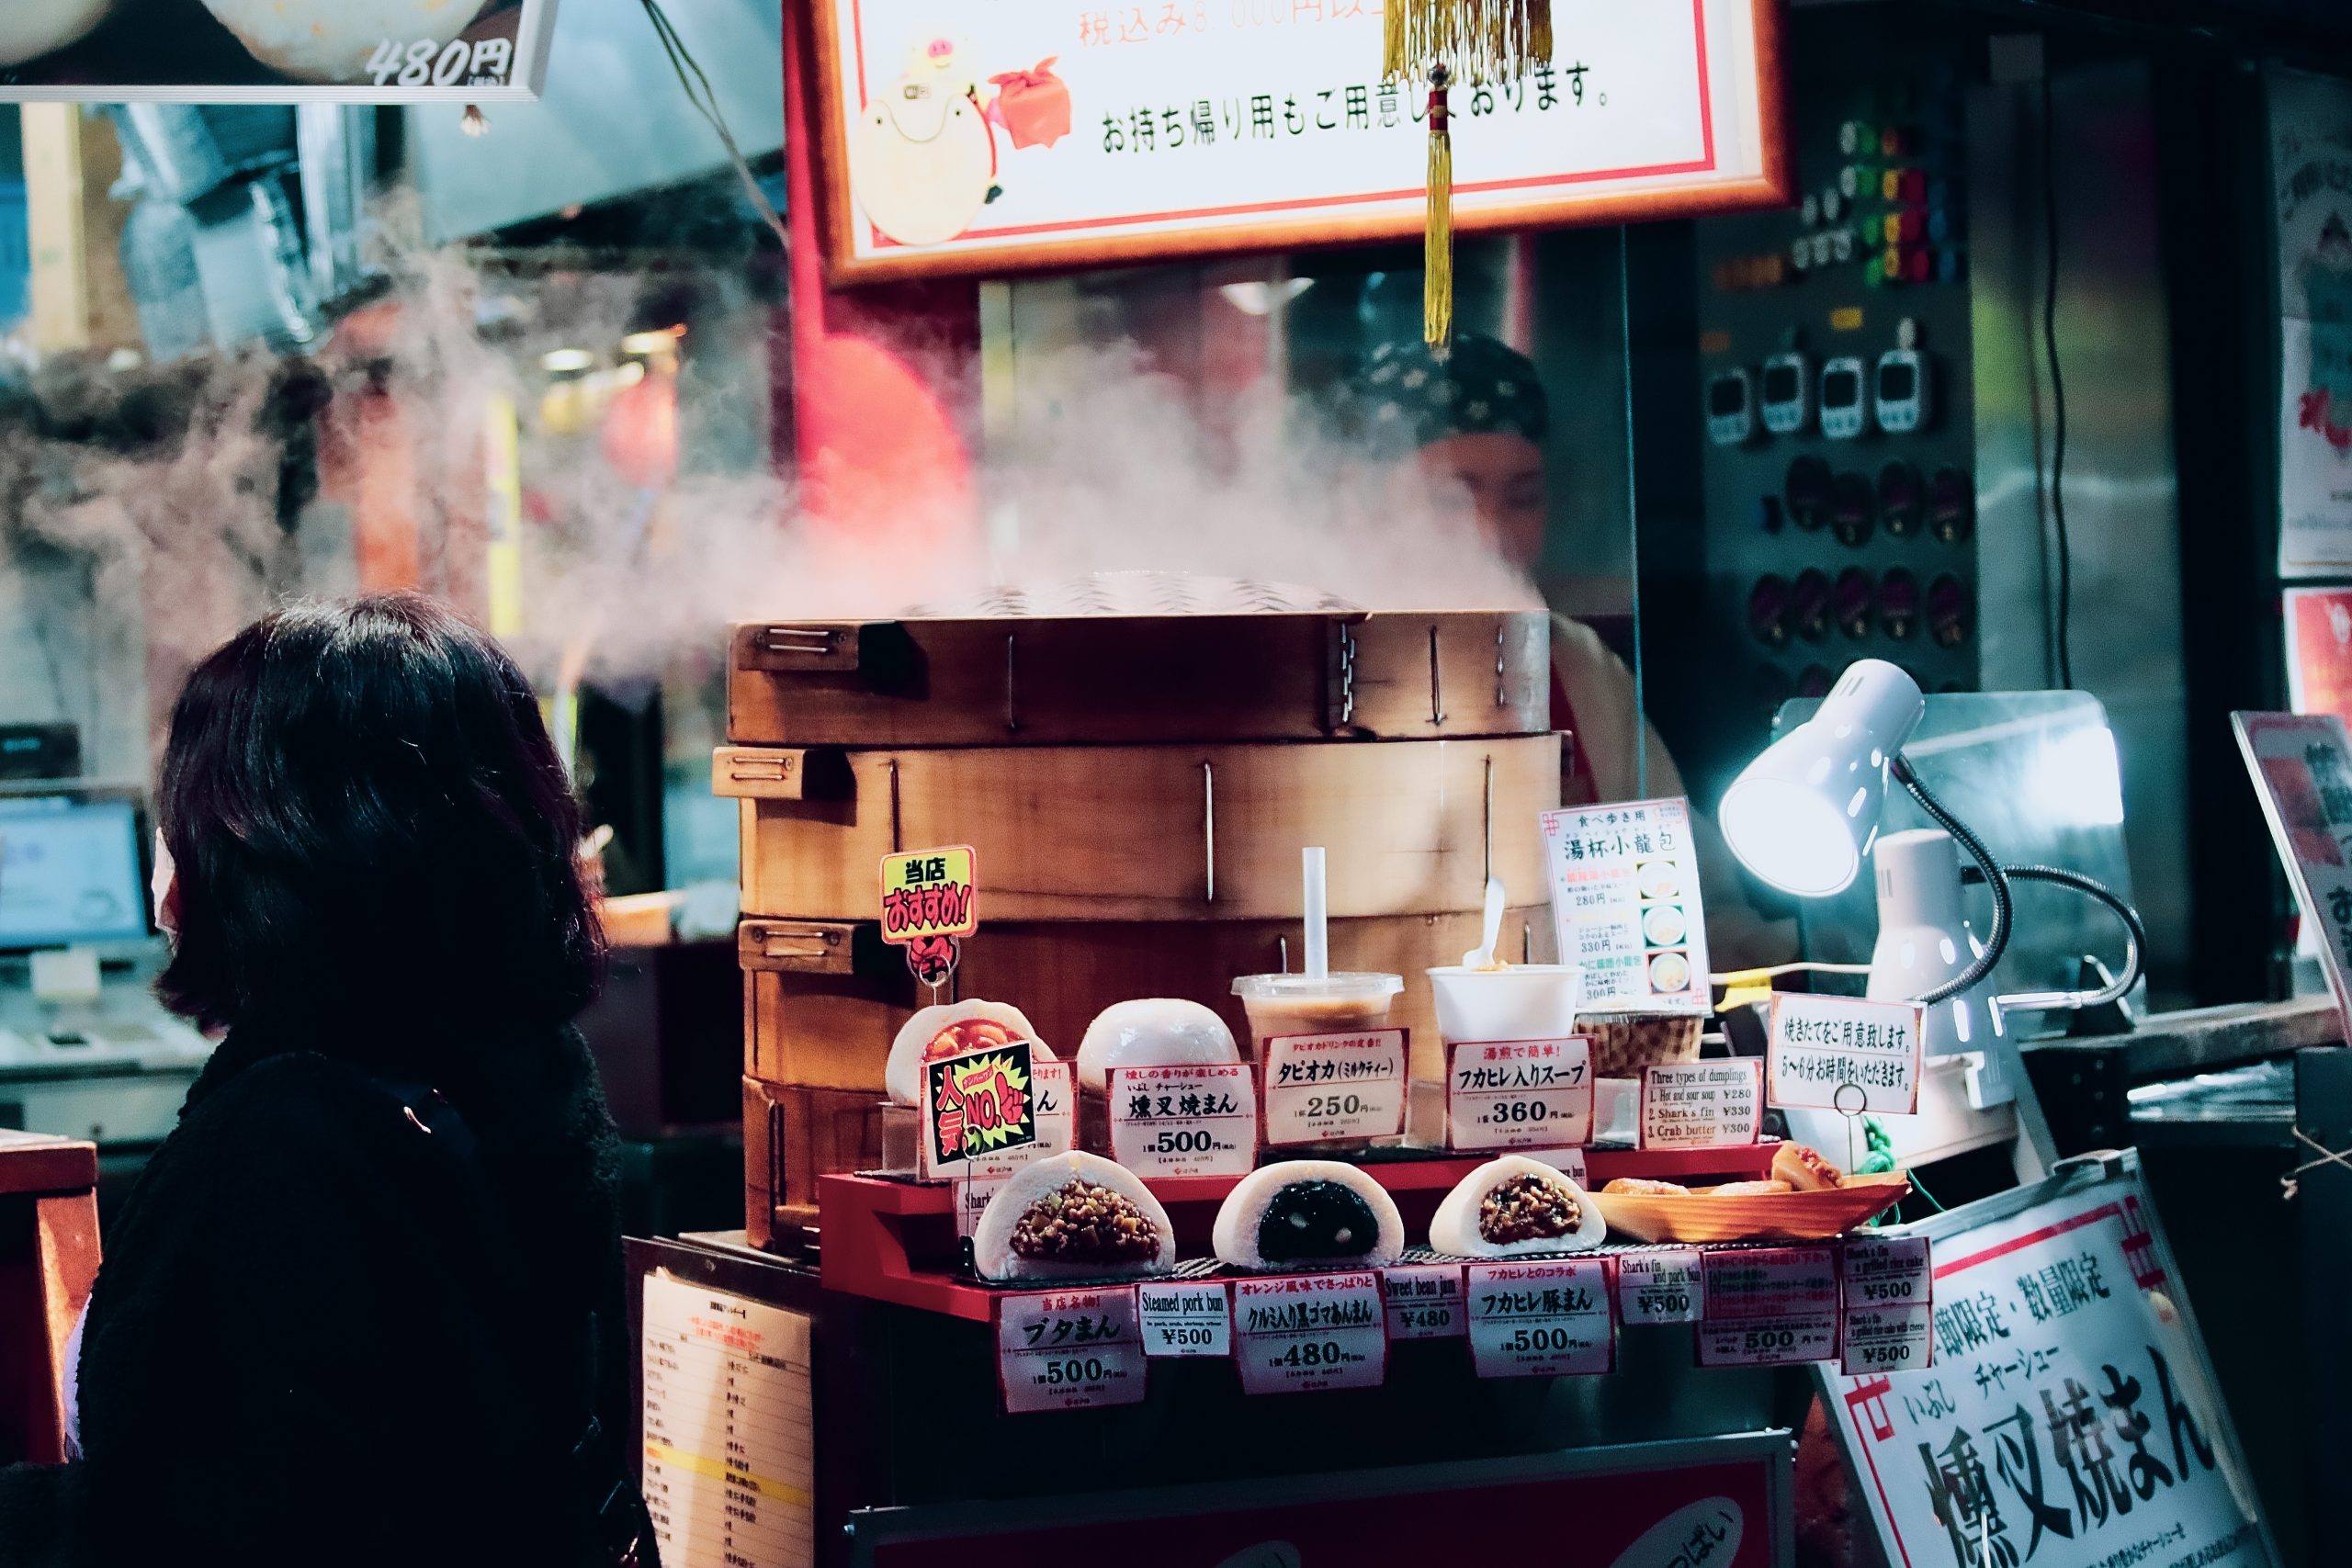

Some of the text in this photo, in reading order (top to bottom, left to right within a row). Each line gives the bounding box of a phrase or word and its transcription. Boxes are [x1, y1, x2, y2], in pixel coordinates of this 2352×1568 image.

[366, 38, 513, 86] 480円
[1102, 61, 1609, 154] お持ち帰り用もご用意しおります。
[1578, 809, 1646, 829] 食べ歩き用
[905, 857, 946, 885] 当店
[884, 881, 971, 933] おすすめ!
[1576, 894, 1606, 906] 280円
[1784, 1015, 1911, 1054] 焼きたてをご用意致します。
[1458, 1060, 1587, 1089] フカヒレ入りスープ
[1651, 1067, 1747, 1085] Three types of dumplings
[1673, 1088, 1685, 1102] and
[1686, 1089, 1700, 1101] sour
[1702, 1089, 1716, 1101] soup
[1723, 1089, 1752, 1100] ¥280
[935, 1065, 965, 1156] 人気
[1657, 1109, 1697, 1119] Sharks
[1700, 1107, 1714, 1117] fin
[1723, 1106, 1751, 1117] ¥330
[1657, 1124, 1682, 1137] Crab
[1686, 1123, 1716, 1134] butter
[1722, 1123, 1750, 1134] ¥300
[1572, 1165, 1586, 1178] bun
[1487, 1265, 1577, 1280] フカヒレとのコラボ
[1385, 1277, 1413, 1297] Sweet
[1415, 1275, 1437, 1296] bean
[1864, 1281, 1912, 1301] ¥500
[1142, 1292, 1224, 1315] Steamed pork bun
[1481, 1287, 1593, 1315] フカヒレ豚まん
[1637, 1294, 1690, 1314] ¥500
[1932, 1251, 2112, 1367] 節限定・数量限定
[1248, 1299, 1374, 1331] クルミ入り黒ゴマあんまん
[1399, 1309, 1451, 1328] ¥480
[1023, 1314, 1121, 1346] ブタまん
[1161, 1328, 1213, 1345] ¥500
[1862, 1345, 1910, 1363] ¥500
[1903, 1345, 2060, 1425] いぶし チャーシュー
